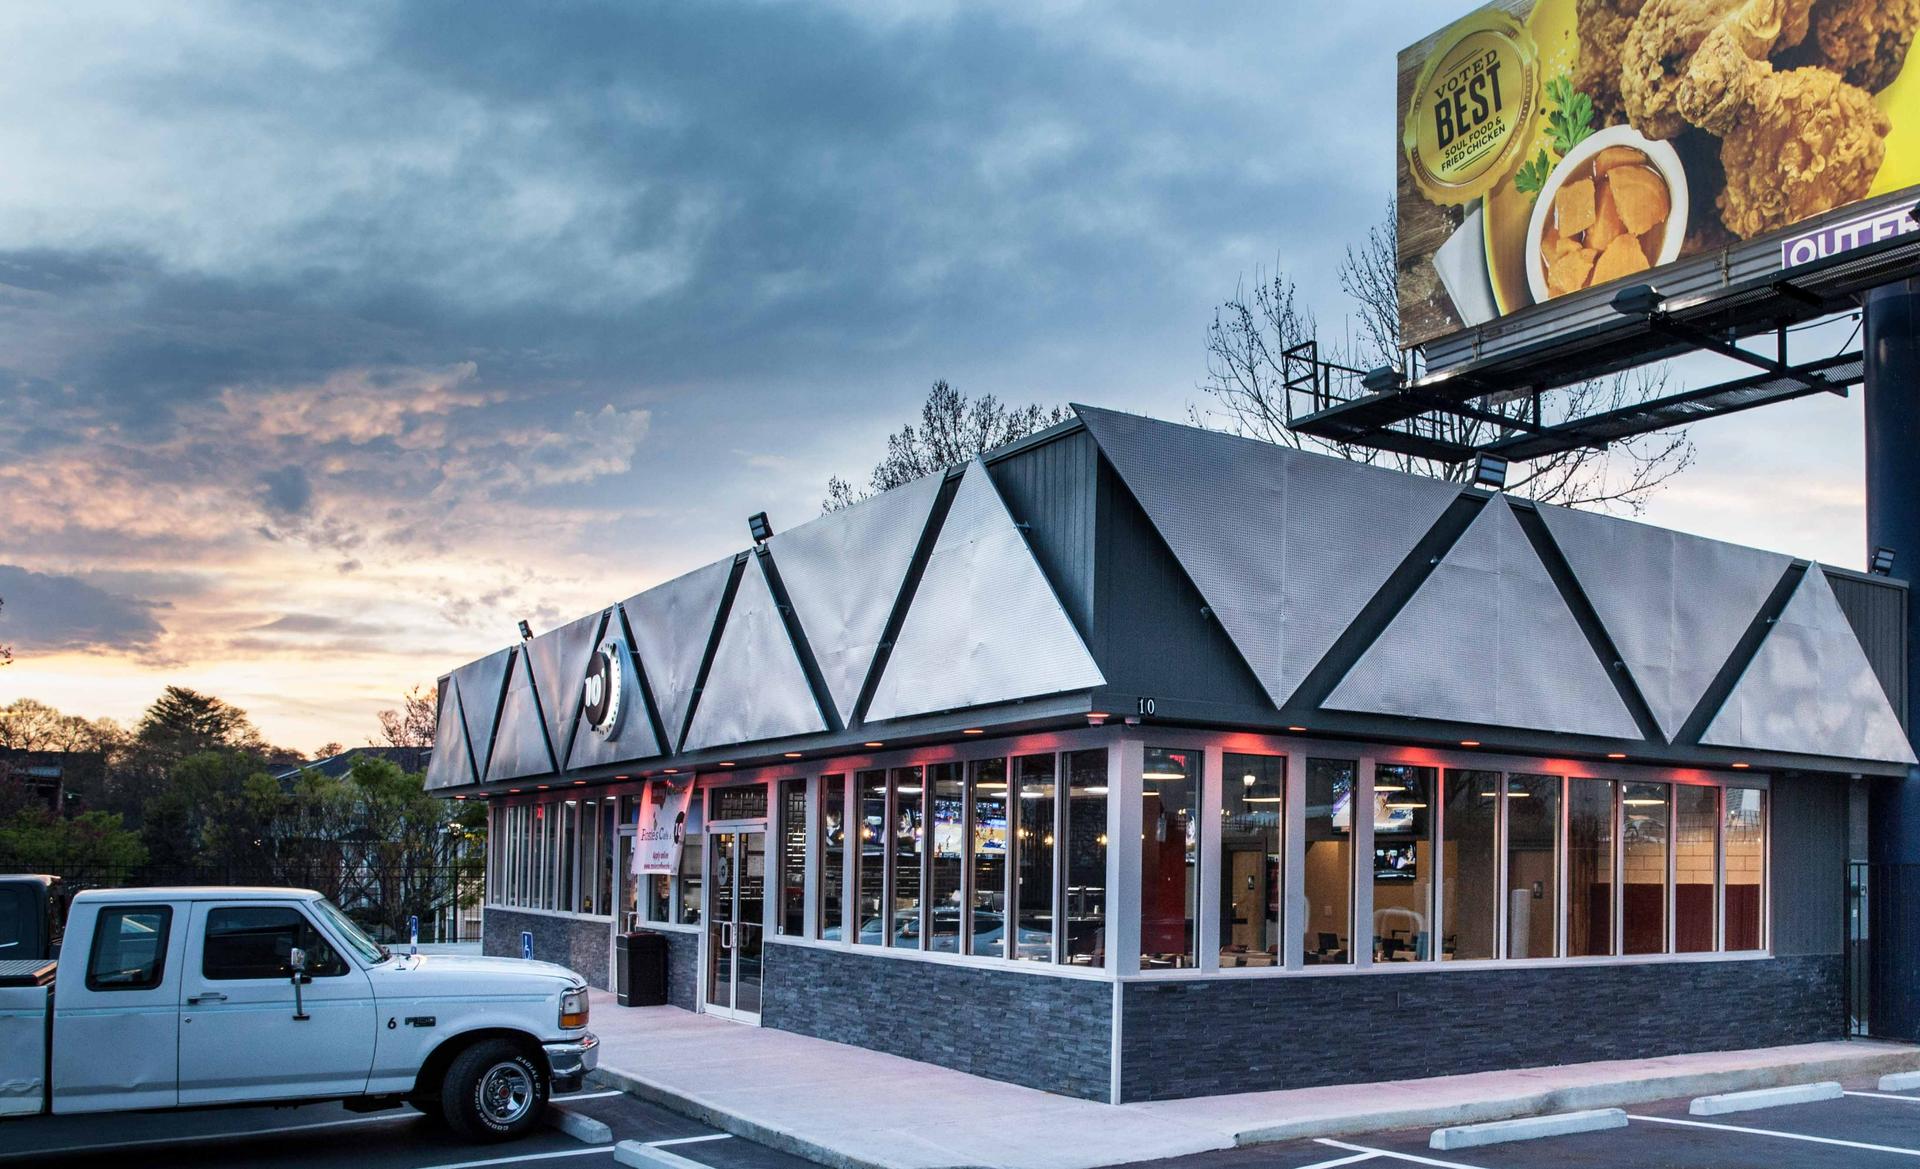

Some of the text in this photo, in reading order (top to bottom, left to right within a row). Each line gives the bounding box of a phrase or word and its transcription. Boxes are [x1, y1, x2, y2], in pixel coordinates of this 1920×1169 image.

[1434, 49, 1498, 99] VOTED
[1434, 61, 1502, 150] BEST
[1441, 124, 1506, 172] FRIED CHICKEN
[1445, 115, 1502, 159] SOUL FOOD &
[1139, 698, 1155, 714] 10
